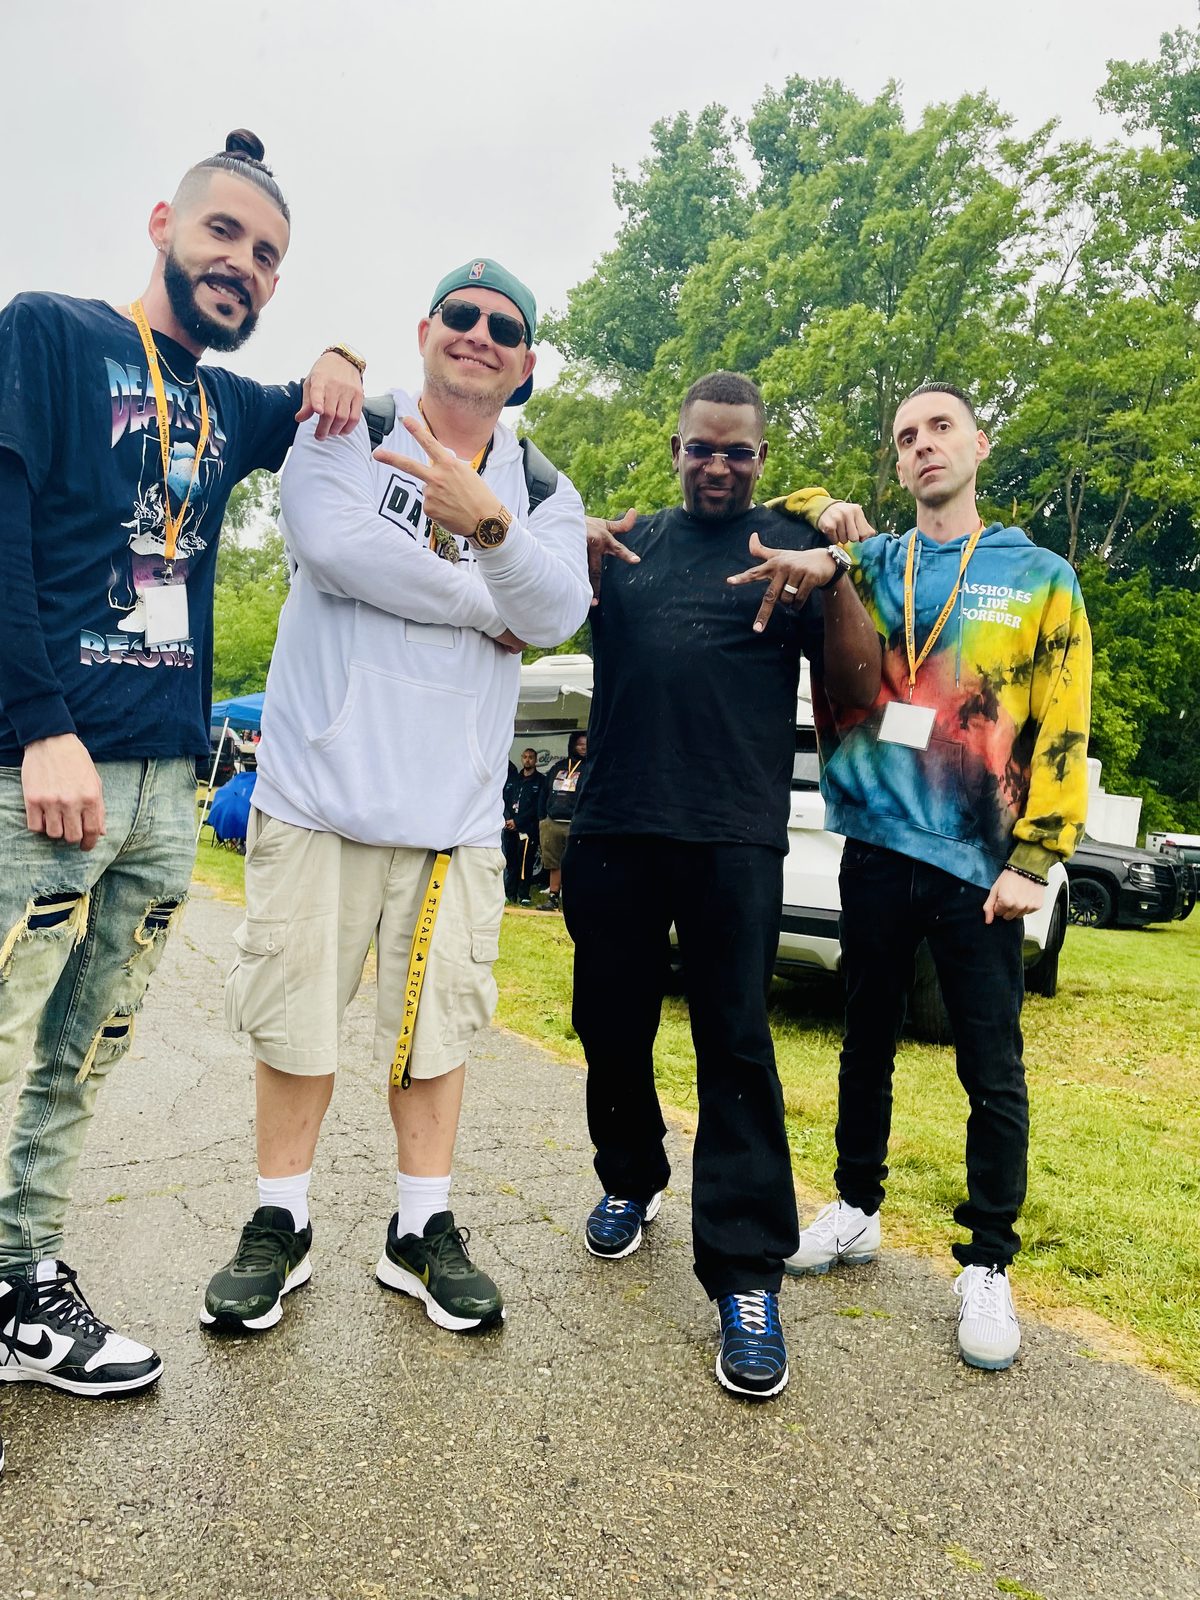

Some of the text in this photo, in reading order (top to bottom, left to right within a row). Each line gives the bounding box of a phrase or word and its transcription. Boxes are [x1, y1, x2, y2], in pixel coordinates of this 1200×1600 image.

[958, 582, 1032, 604] ASSHOLES
[977, 596, 1009, 611] LIVE
[923, 635, 936, 654] Lawyers
[932, 626, 940, 636] Who
[937, 617, 945, 627] Roll
[419, 898, 436, 944] TICAL
[406, 970, 421, 1016] TICAL
